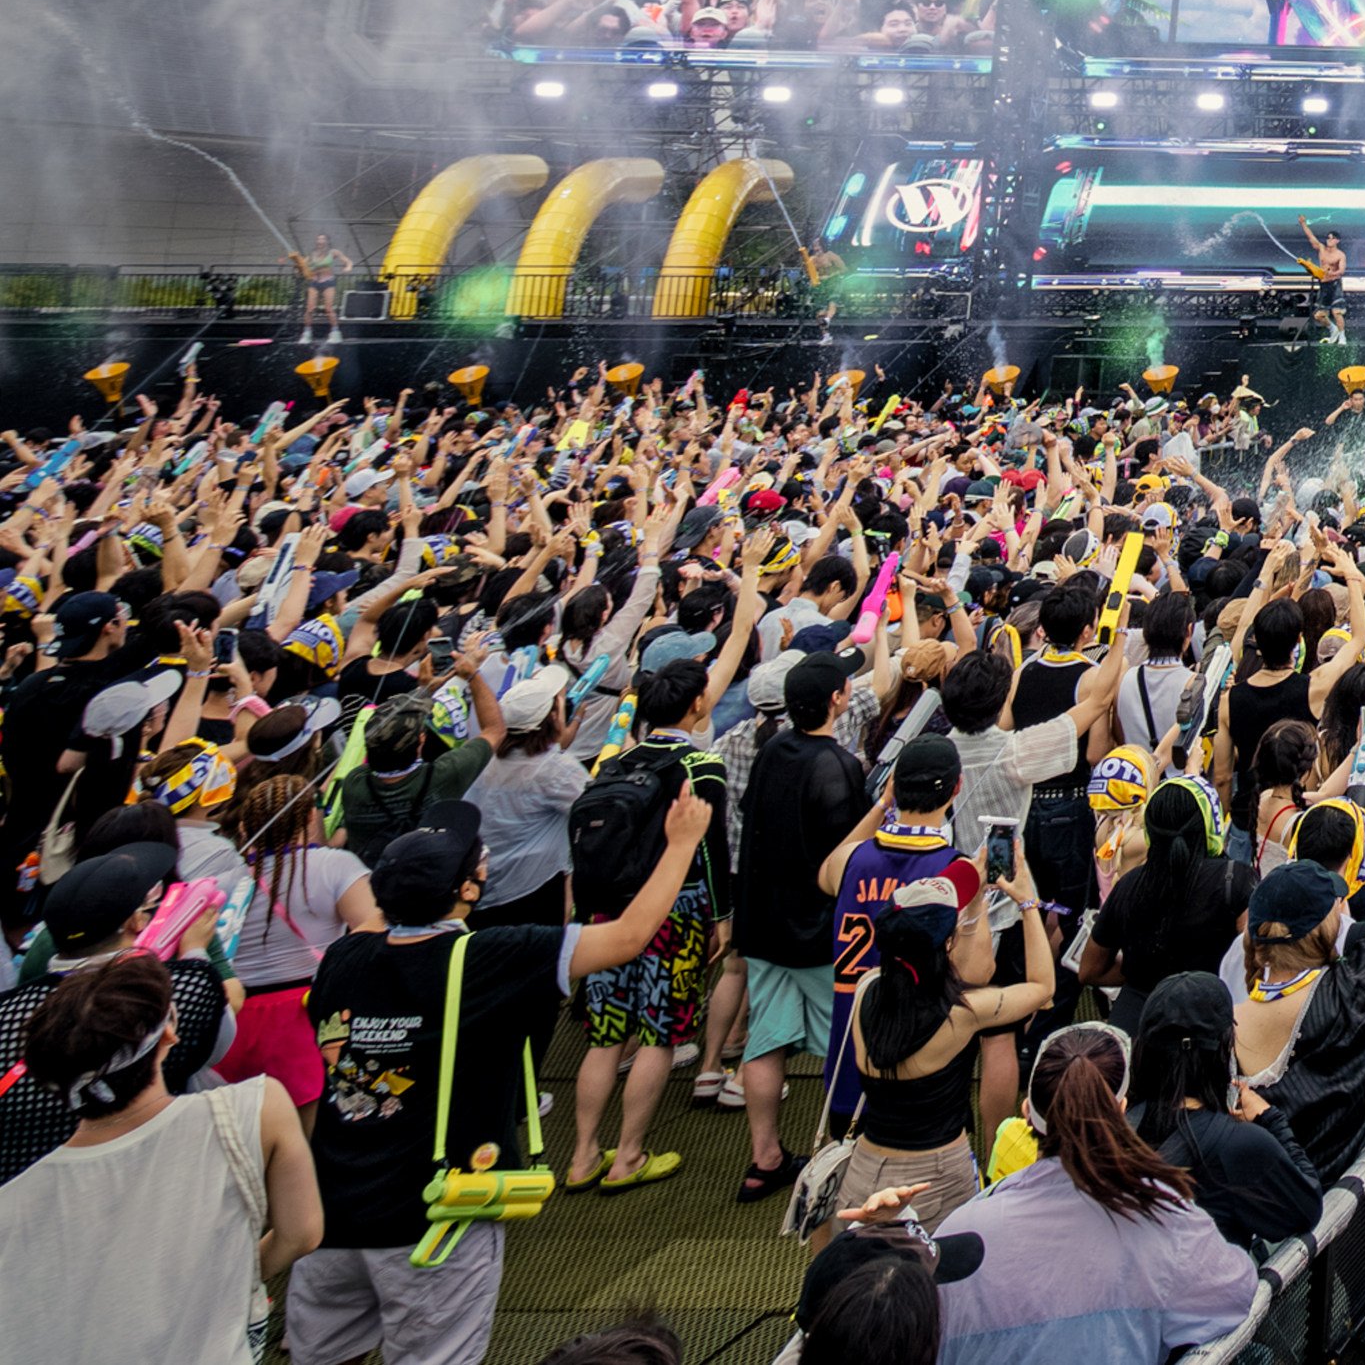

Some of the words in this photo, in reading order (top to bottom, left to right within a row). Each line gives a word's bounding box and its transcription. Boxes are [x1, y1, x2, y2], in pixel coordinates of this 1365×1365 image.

[351, 1017, 389, 1030] ENJOY
[390, 1016, 424, 1029] YOUR
[350, 1029, 408, 1043] WEEKEND
